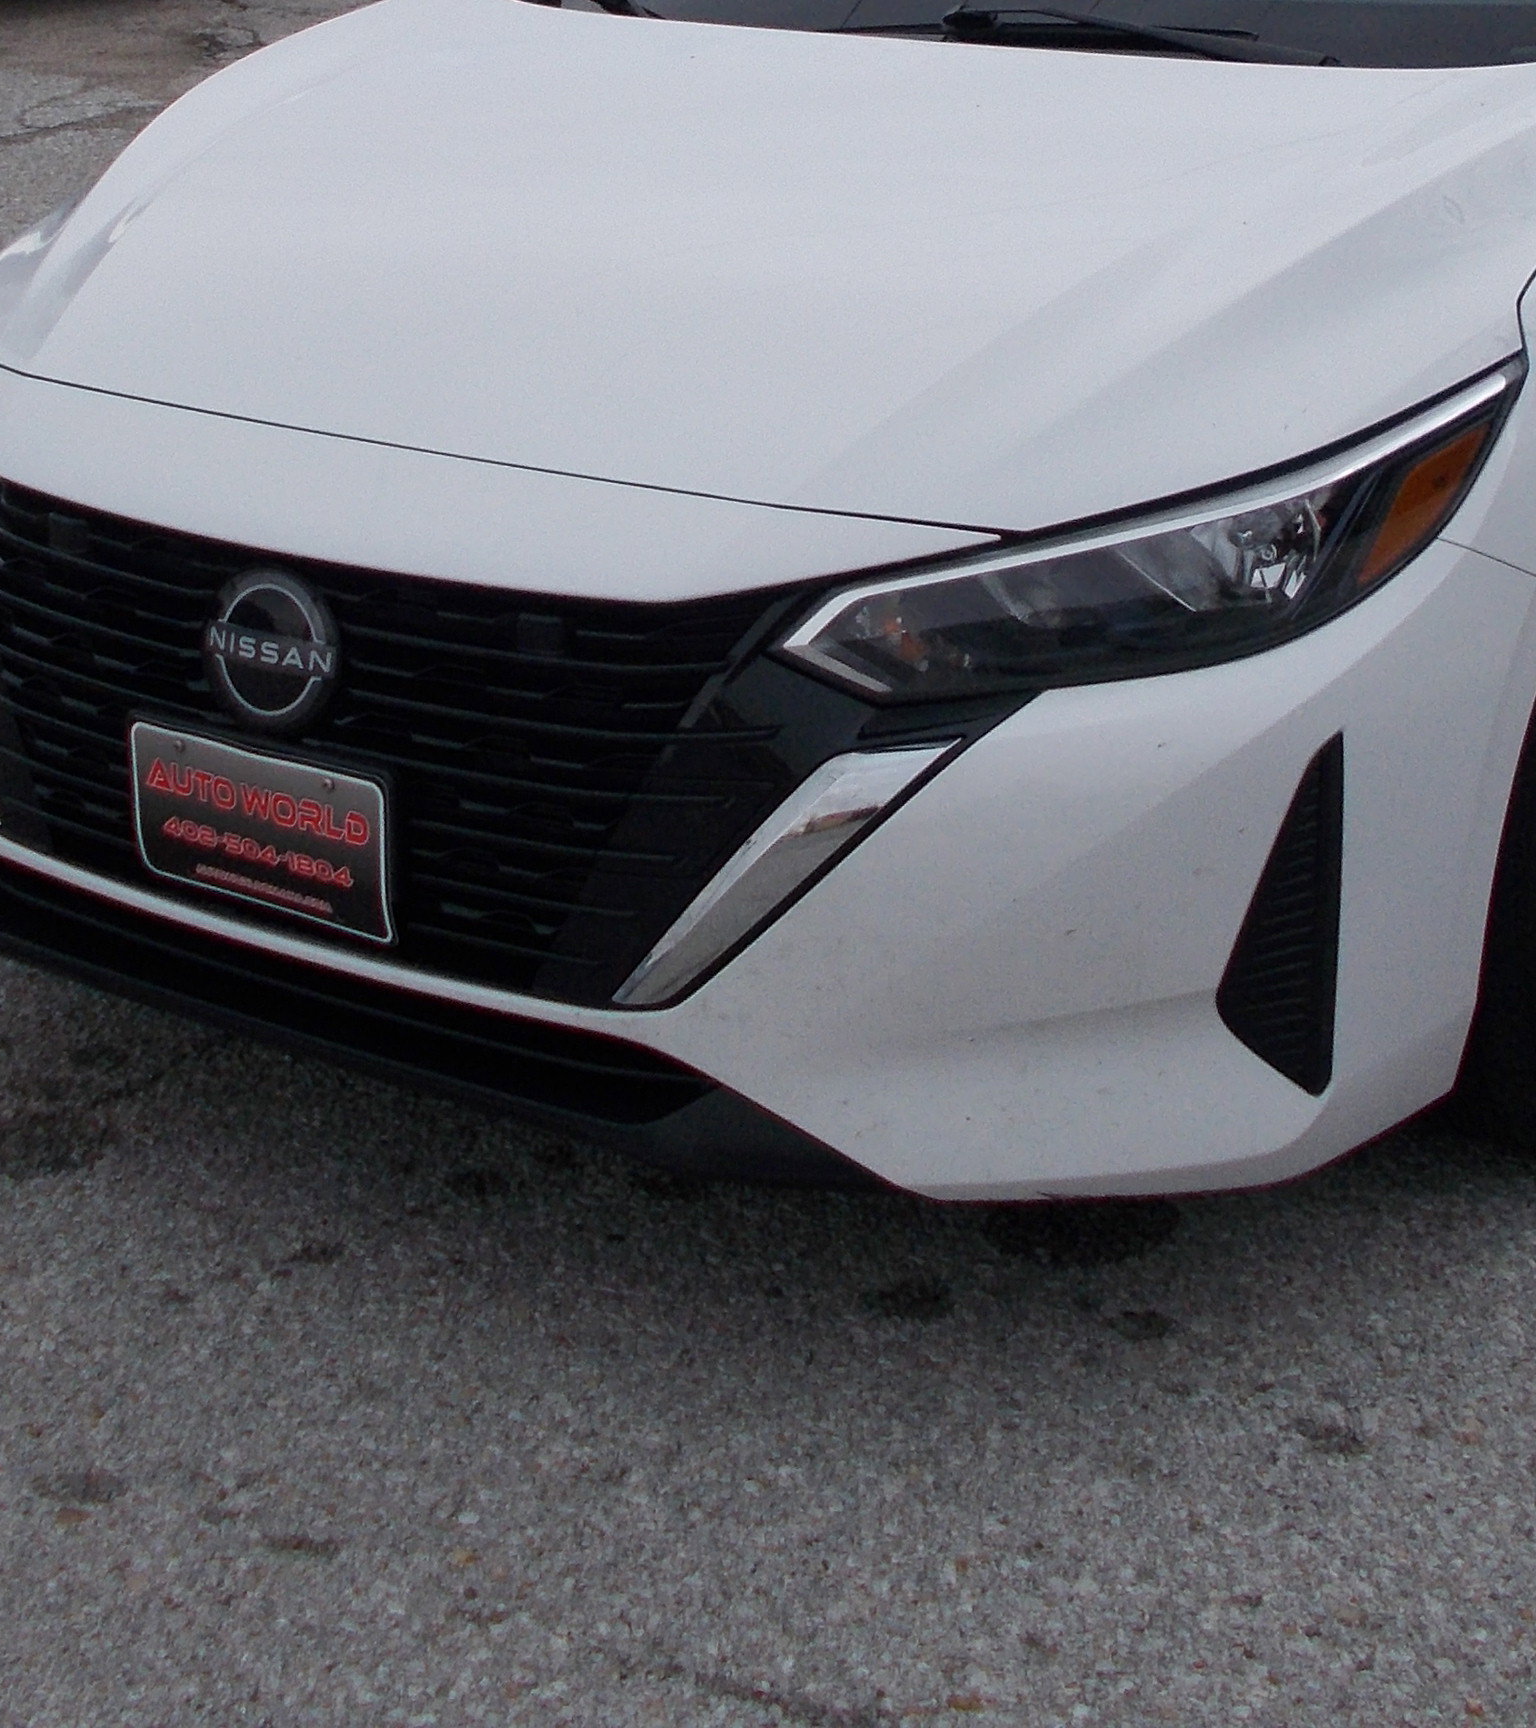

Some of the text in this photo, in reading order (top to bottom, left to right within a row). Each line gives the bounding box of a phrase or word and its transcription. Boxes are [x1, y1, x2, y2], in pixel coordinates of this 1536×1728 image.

[209, 628, 334, 674] NISSAN
[146, 757, 371, 846] AUTO WORLD
[163, 816, 355, 888] 402-504-1804
